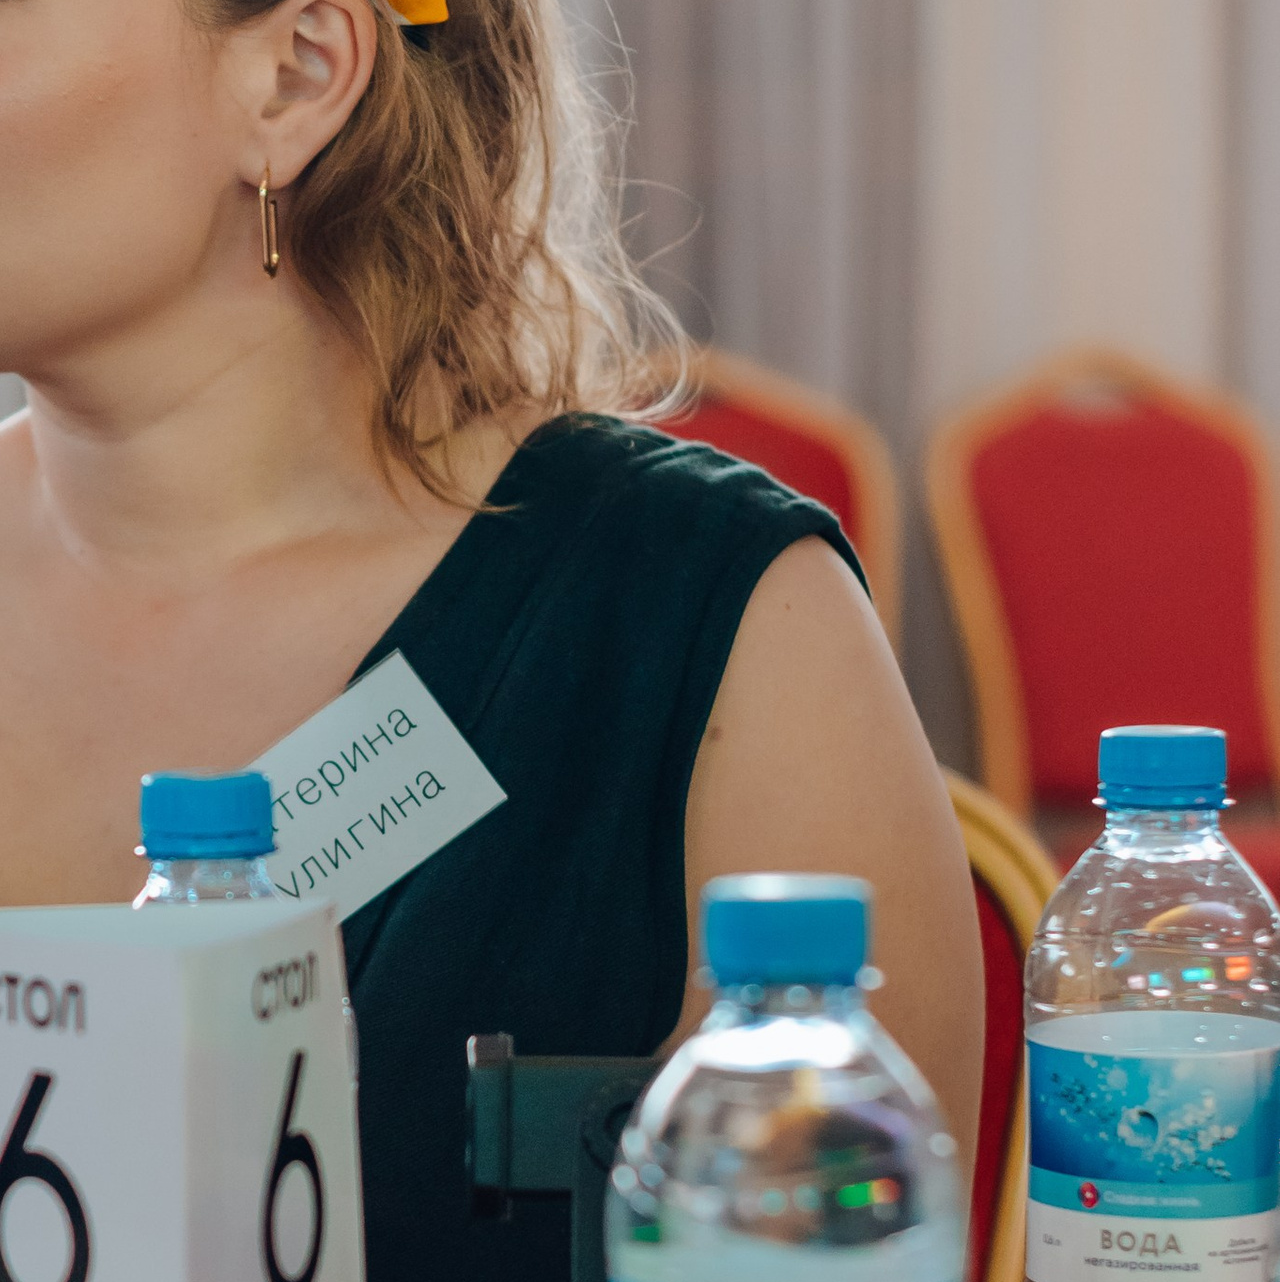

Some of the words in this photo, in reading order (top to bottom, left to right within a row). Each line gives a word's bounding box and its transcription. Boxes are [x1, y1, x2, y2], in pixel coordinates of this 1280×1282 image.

[271, 708, 418, 832] терина
[275, 770, 446, 900] улигина
[252, 950, 318, 1020] СТОЛ
[1084, 1256, 1201, 1273] негазированная
[1100, 1228, 1182, 1257] ВОДА
